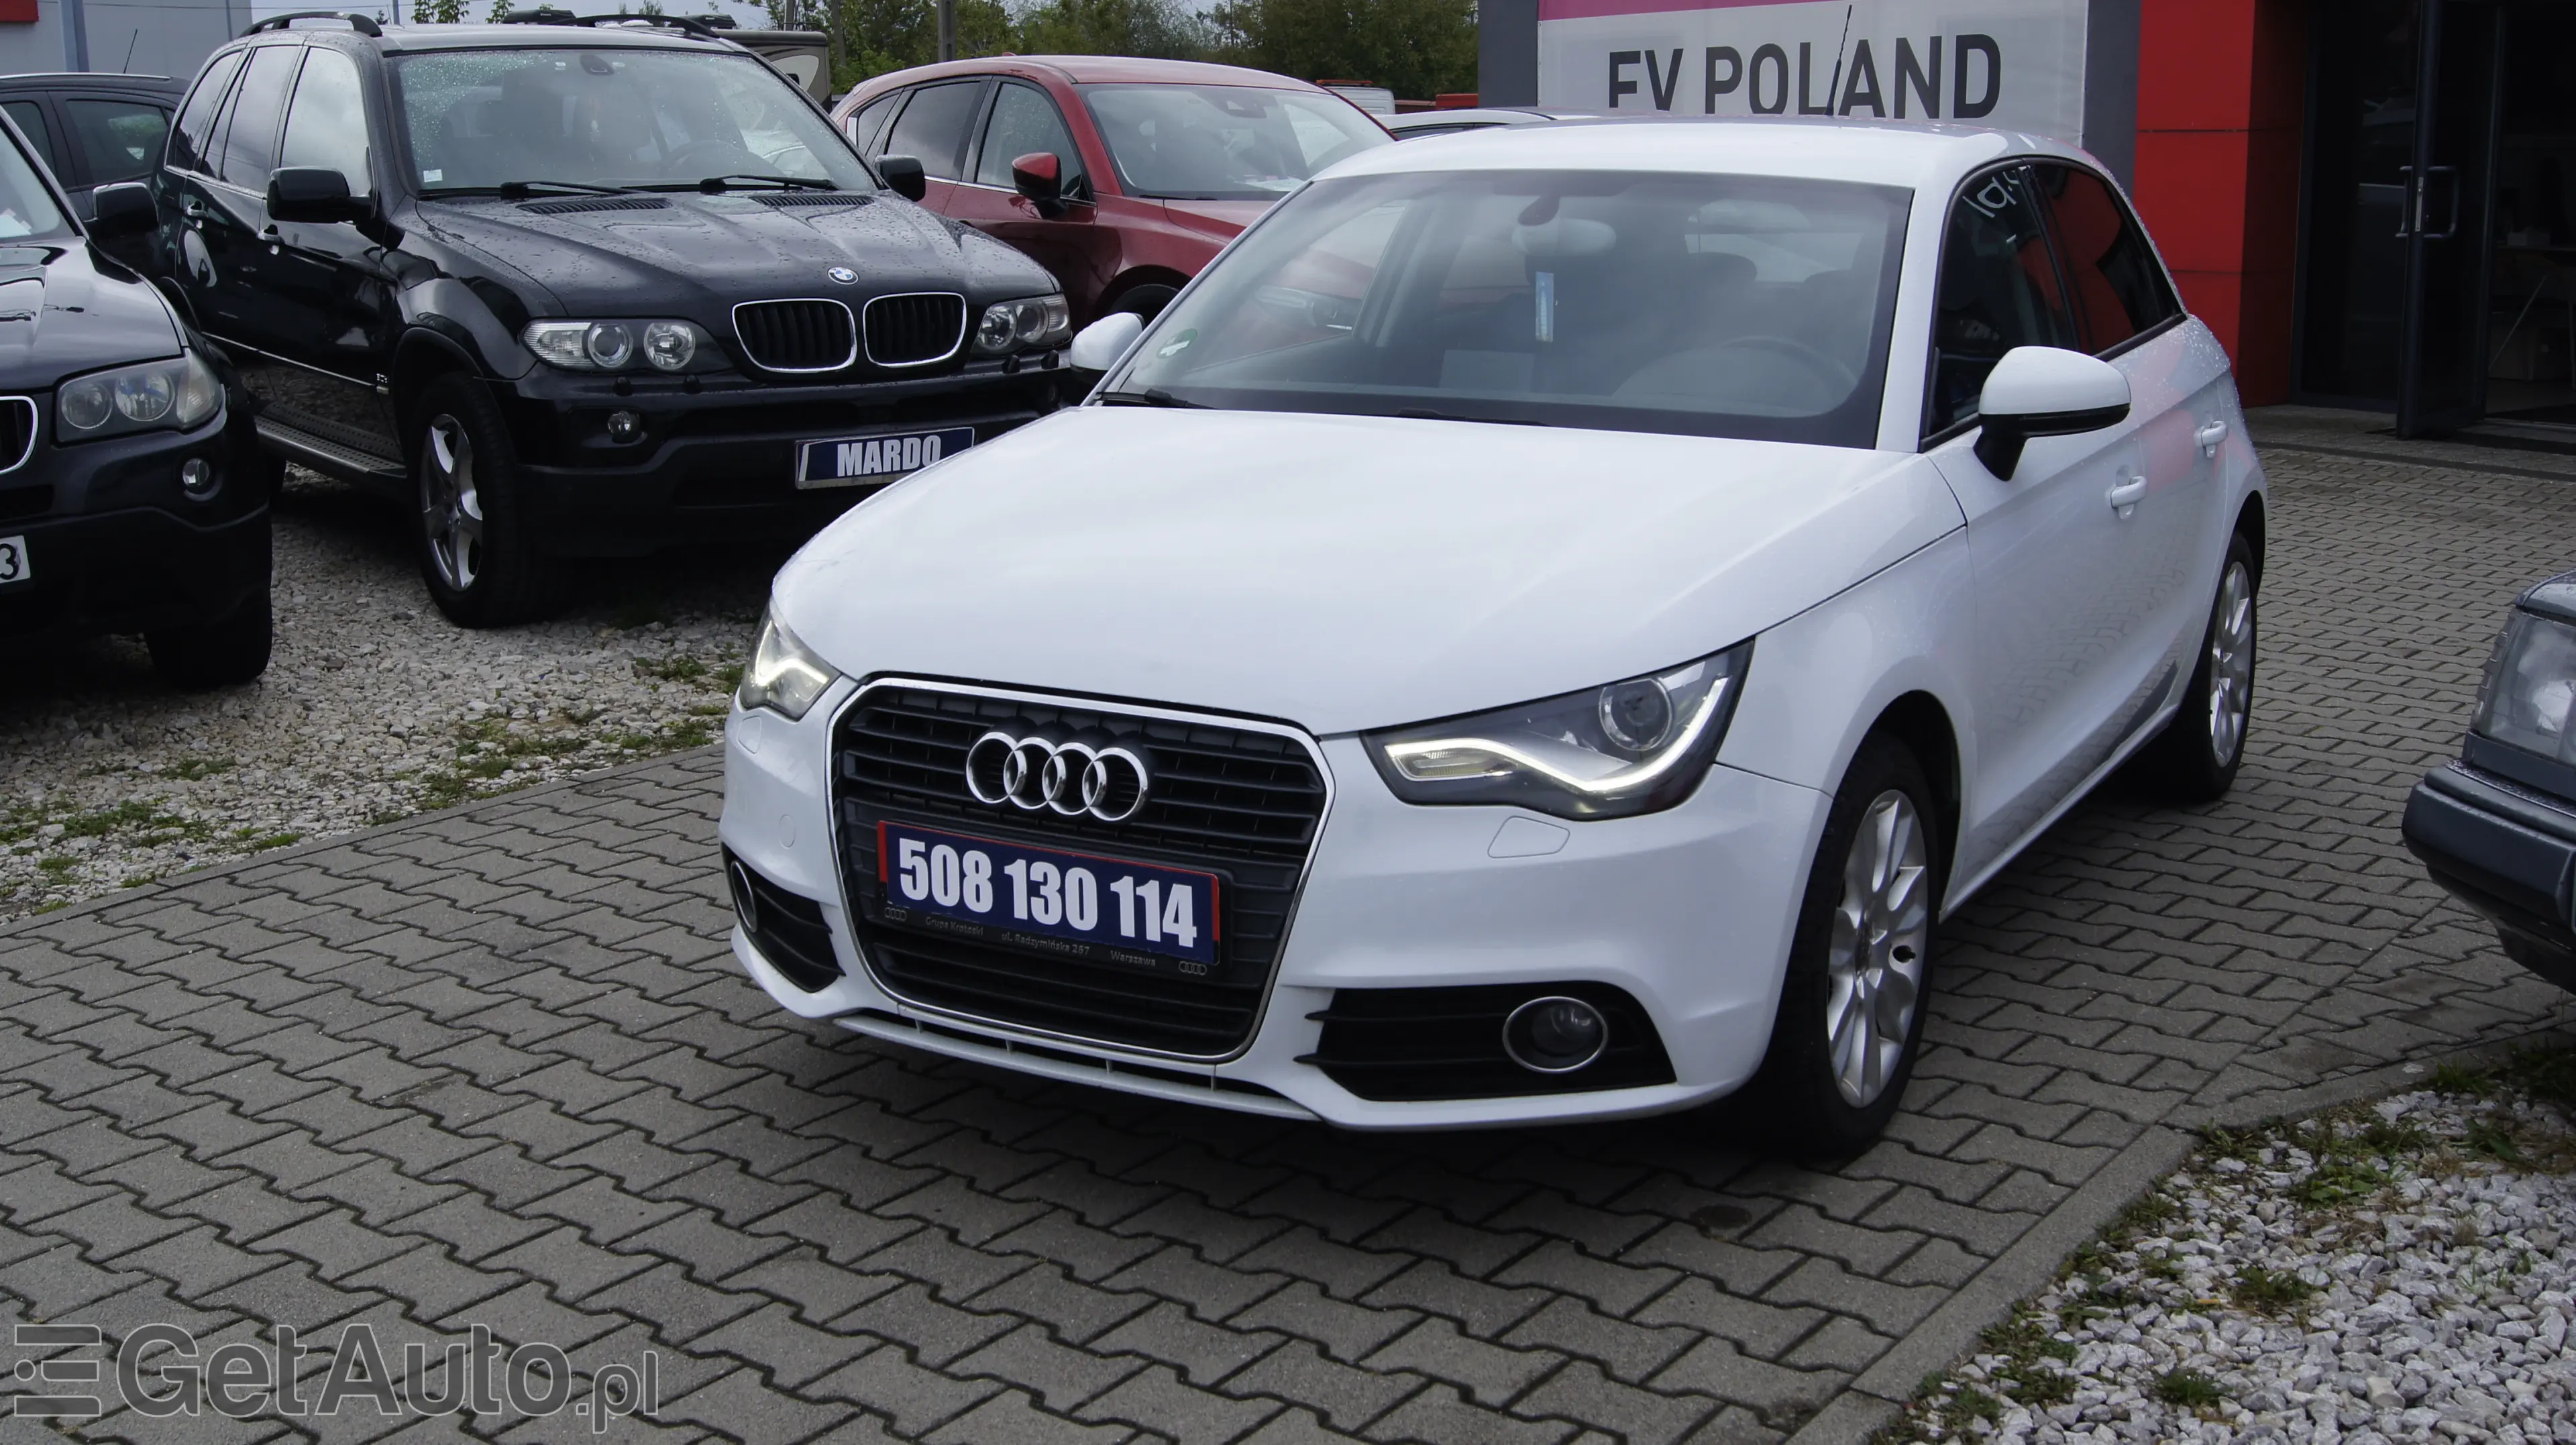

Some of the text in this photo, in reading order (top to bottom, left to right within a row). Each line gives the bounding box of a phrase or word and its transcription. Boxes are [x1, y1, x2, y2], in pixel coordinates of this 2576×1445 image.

[1705, 34, 2002, 119] POLAND
[837, 435, 942, 478] MARDO
[899, 837, 1197, 948] 508 130 114
[926, 916, 949, 929] Grupa
[1072, 944, 1090, 955] 267
[1110, 950, 1157, 967] Warszawa
